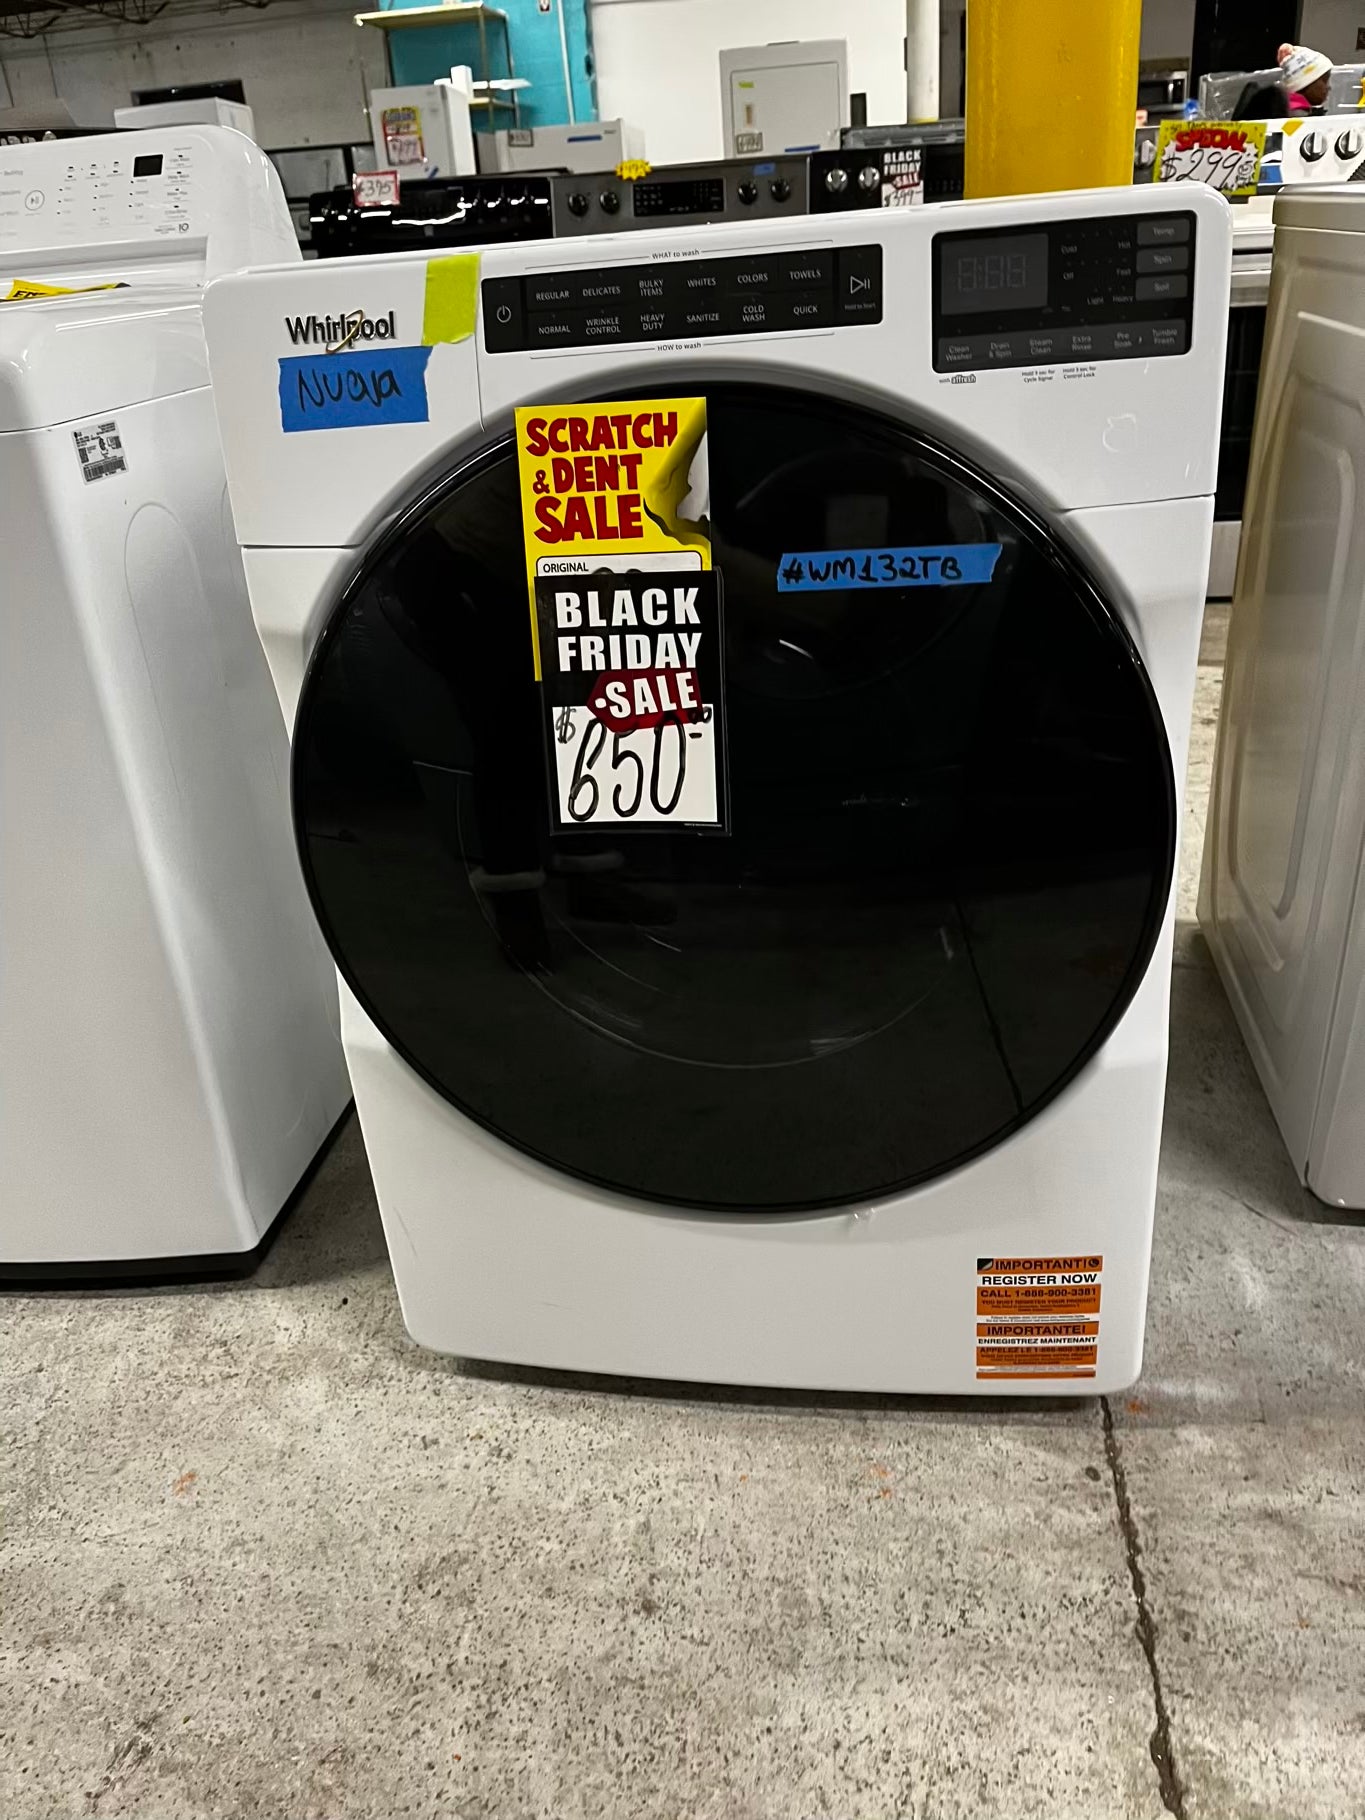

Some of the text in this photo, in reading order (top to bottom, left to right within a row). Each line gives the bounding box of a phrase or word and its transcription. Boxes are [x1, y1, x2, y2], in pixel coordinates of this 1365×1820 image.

[883, 149, 921, 163] BLACK
[883, 161, 921, 176] FRIDAY
[895, 172, 919, 187] SALE
[652, 251, 672, 259] WHAT
[682, 249, 700, 257] wash
[639, 279, 664, 288] BULKY
[687, 269, 821, 287] WHITES COLORS TOWELS
[536, 286, 621, 301] REGULAR DELICATES
[640, 287, 663, 297] ITEMS
[743, 305, 764, 313] COLD
[793, 305, 818, 316] QUICK
[586, 317, 619, 327] WRINKLE
[640, 313, 665, 323] HEAVY
[686, 313, 720, 323] SANITIZE
[742, 313, 765, 322] WASH
[285, 310, 396, 350] Whirlpool
[538, 325, 571, 335] NORMAL
[585, 325, 621, 335] CONTROL
[642, 322, 664, 331] DUTY
[526, 412, 678, 457] SCRATCH
[532, 453, 642, 494] & DENT
[534, 494, 644, 544] SALE
[543, 562, 589, 573] ORIGINAL
[782, 553, 963, 584] #WM132TB
[554, 587, 701, 628] BLACK
[557, 632, 702, 672] FRIDAY
[605, 672, 698, 719] SALE
[995, 1257, 1088, 1271] IMPORTANT!
[982, 1273, 1097, 1286] REGISTER NOW
[980, 1289, 1011, 1298] CALL
[987, 1324, 1086, 1336] IMPORTANTE!
